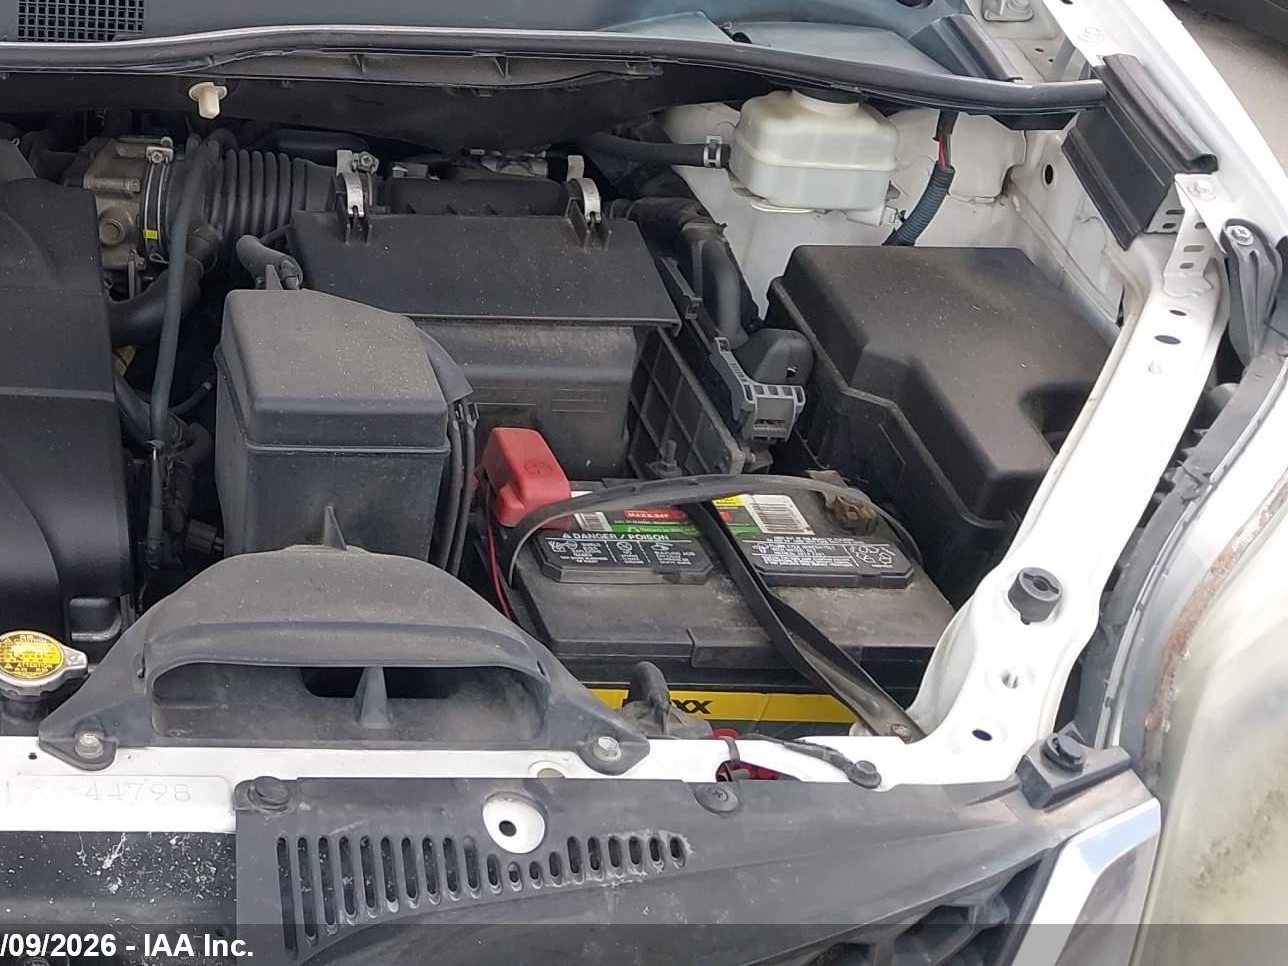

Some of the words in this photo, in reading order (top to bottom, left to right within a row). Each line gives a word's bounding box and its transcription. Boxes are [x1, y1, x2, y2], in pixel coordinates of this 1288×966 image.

[571, 532, 617, 540] DANGER
[626, 533, 670, 541] POISON
[16, 662, 53, 670] ATTENTION
[84, 782, 192, 803] 44798
